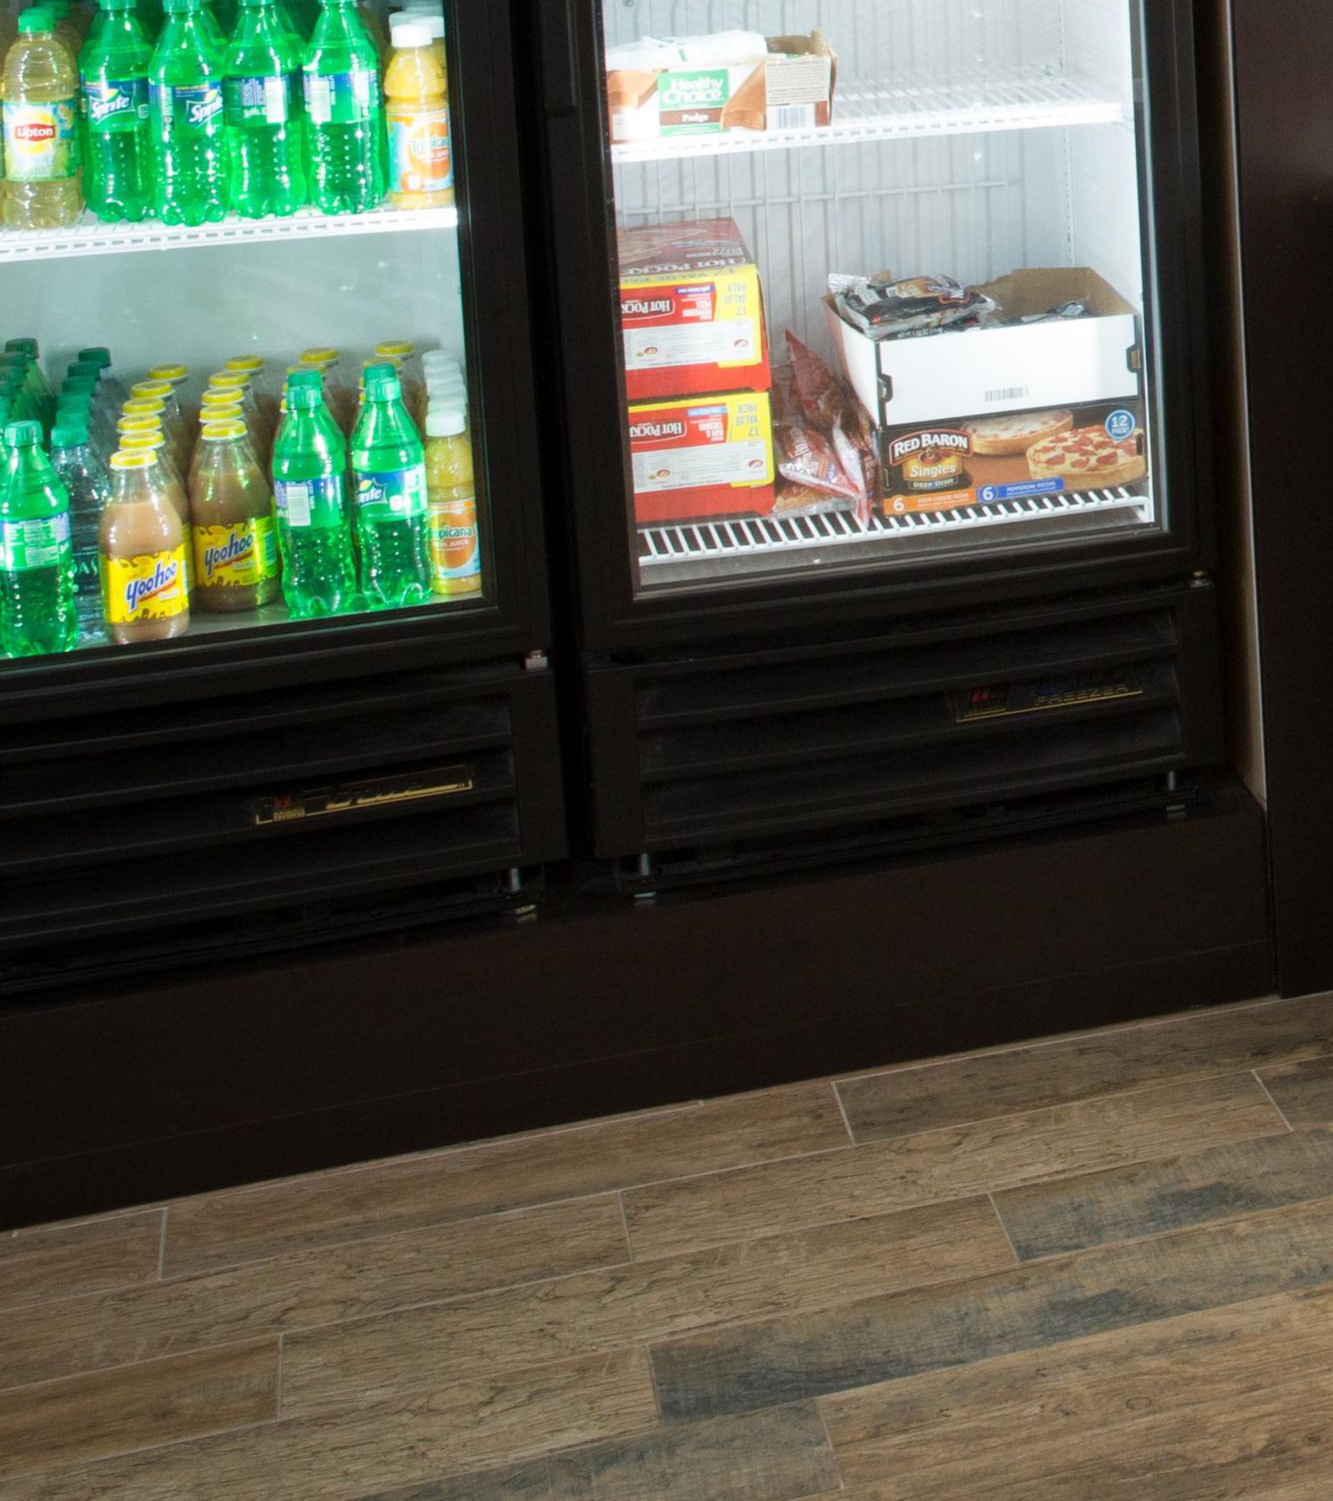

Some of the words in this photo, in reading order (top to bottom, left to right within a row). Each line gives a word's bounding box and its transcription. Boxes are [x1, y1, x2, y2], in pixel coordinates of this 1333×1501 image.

[90, 95, 130, 119] Sprite
[187, 94, 223, 123] Sprit
[16, 124, 54, 139] Lipton
[621, 299, 649, 315] POCK
[650, 299, 671, 313] HOT
[662, 421, 682, 435] HOT
[1111, 414, 1128, 427] 12
[630, 422, 661, 437] POCK
[894, 437, 920, 458] RED
[921, 433, 968, 450] BARON
[910, 464, 957, 478] Singles
[982, 486, 994, 501] 6
[892, 497, 905, 512] 6
[435, 527, 474, 542] picana
[71, 556, 99, 575] DAS
